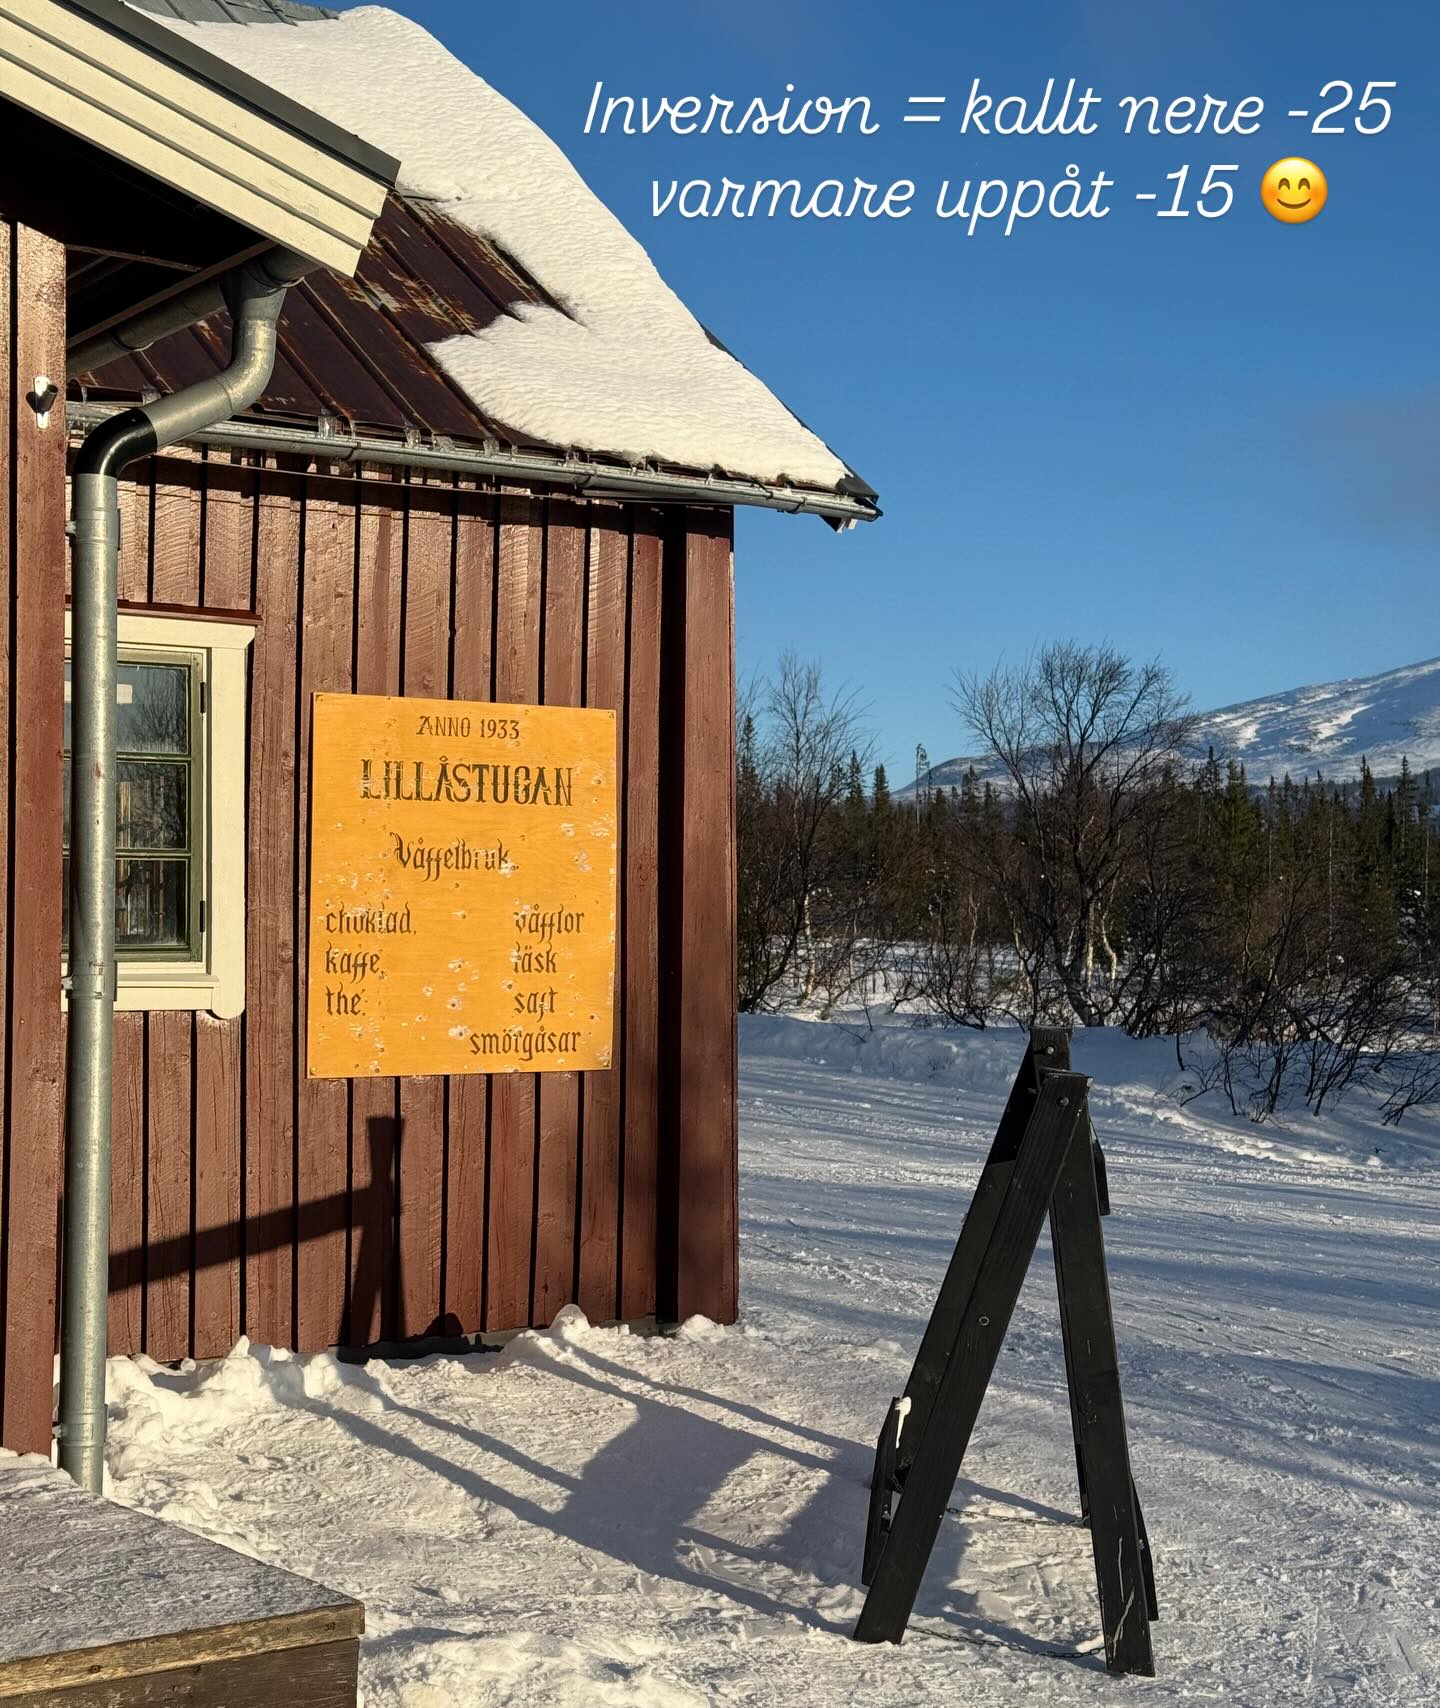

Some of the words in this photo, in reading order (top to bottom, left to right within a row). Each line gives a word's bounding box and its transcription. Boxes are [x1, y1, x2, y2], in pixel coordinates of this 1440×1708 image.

[416, 715, 471, 738] ANNO
[480, 718, 520, 740] 1933
[360, 755, 574, 806] LILLÅSTUGAN
[513, 903, 585, 944] våfflor
[514, 986, 558, 1023] saft
[469, 1025, 581, 1062] smörgåsar
